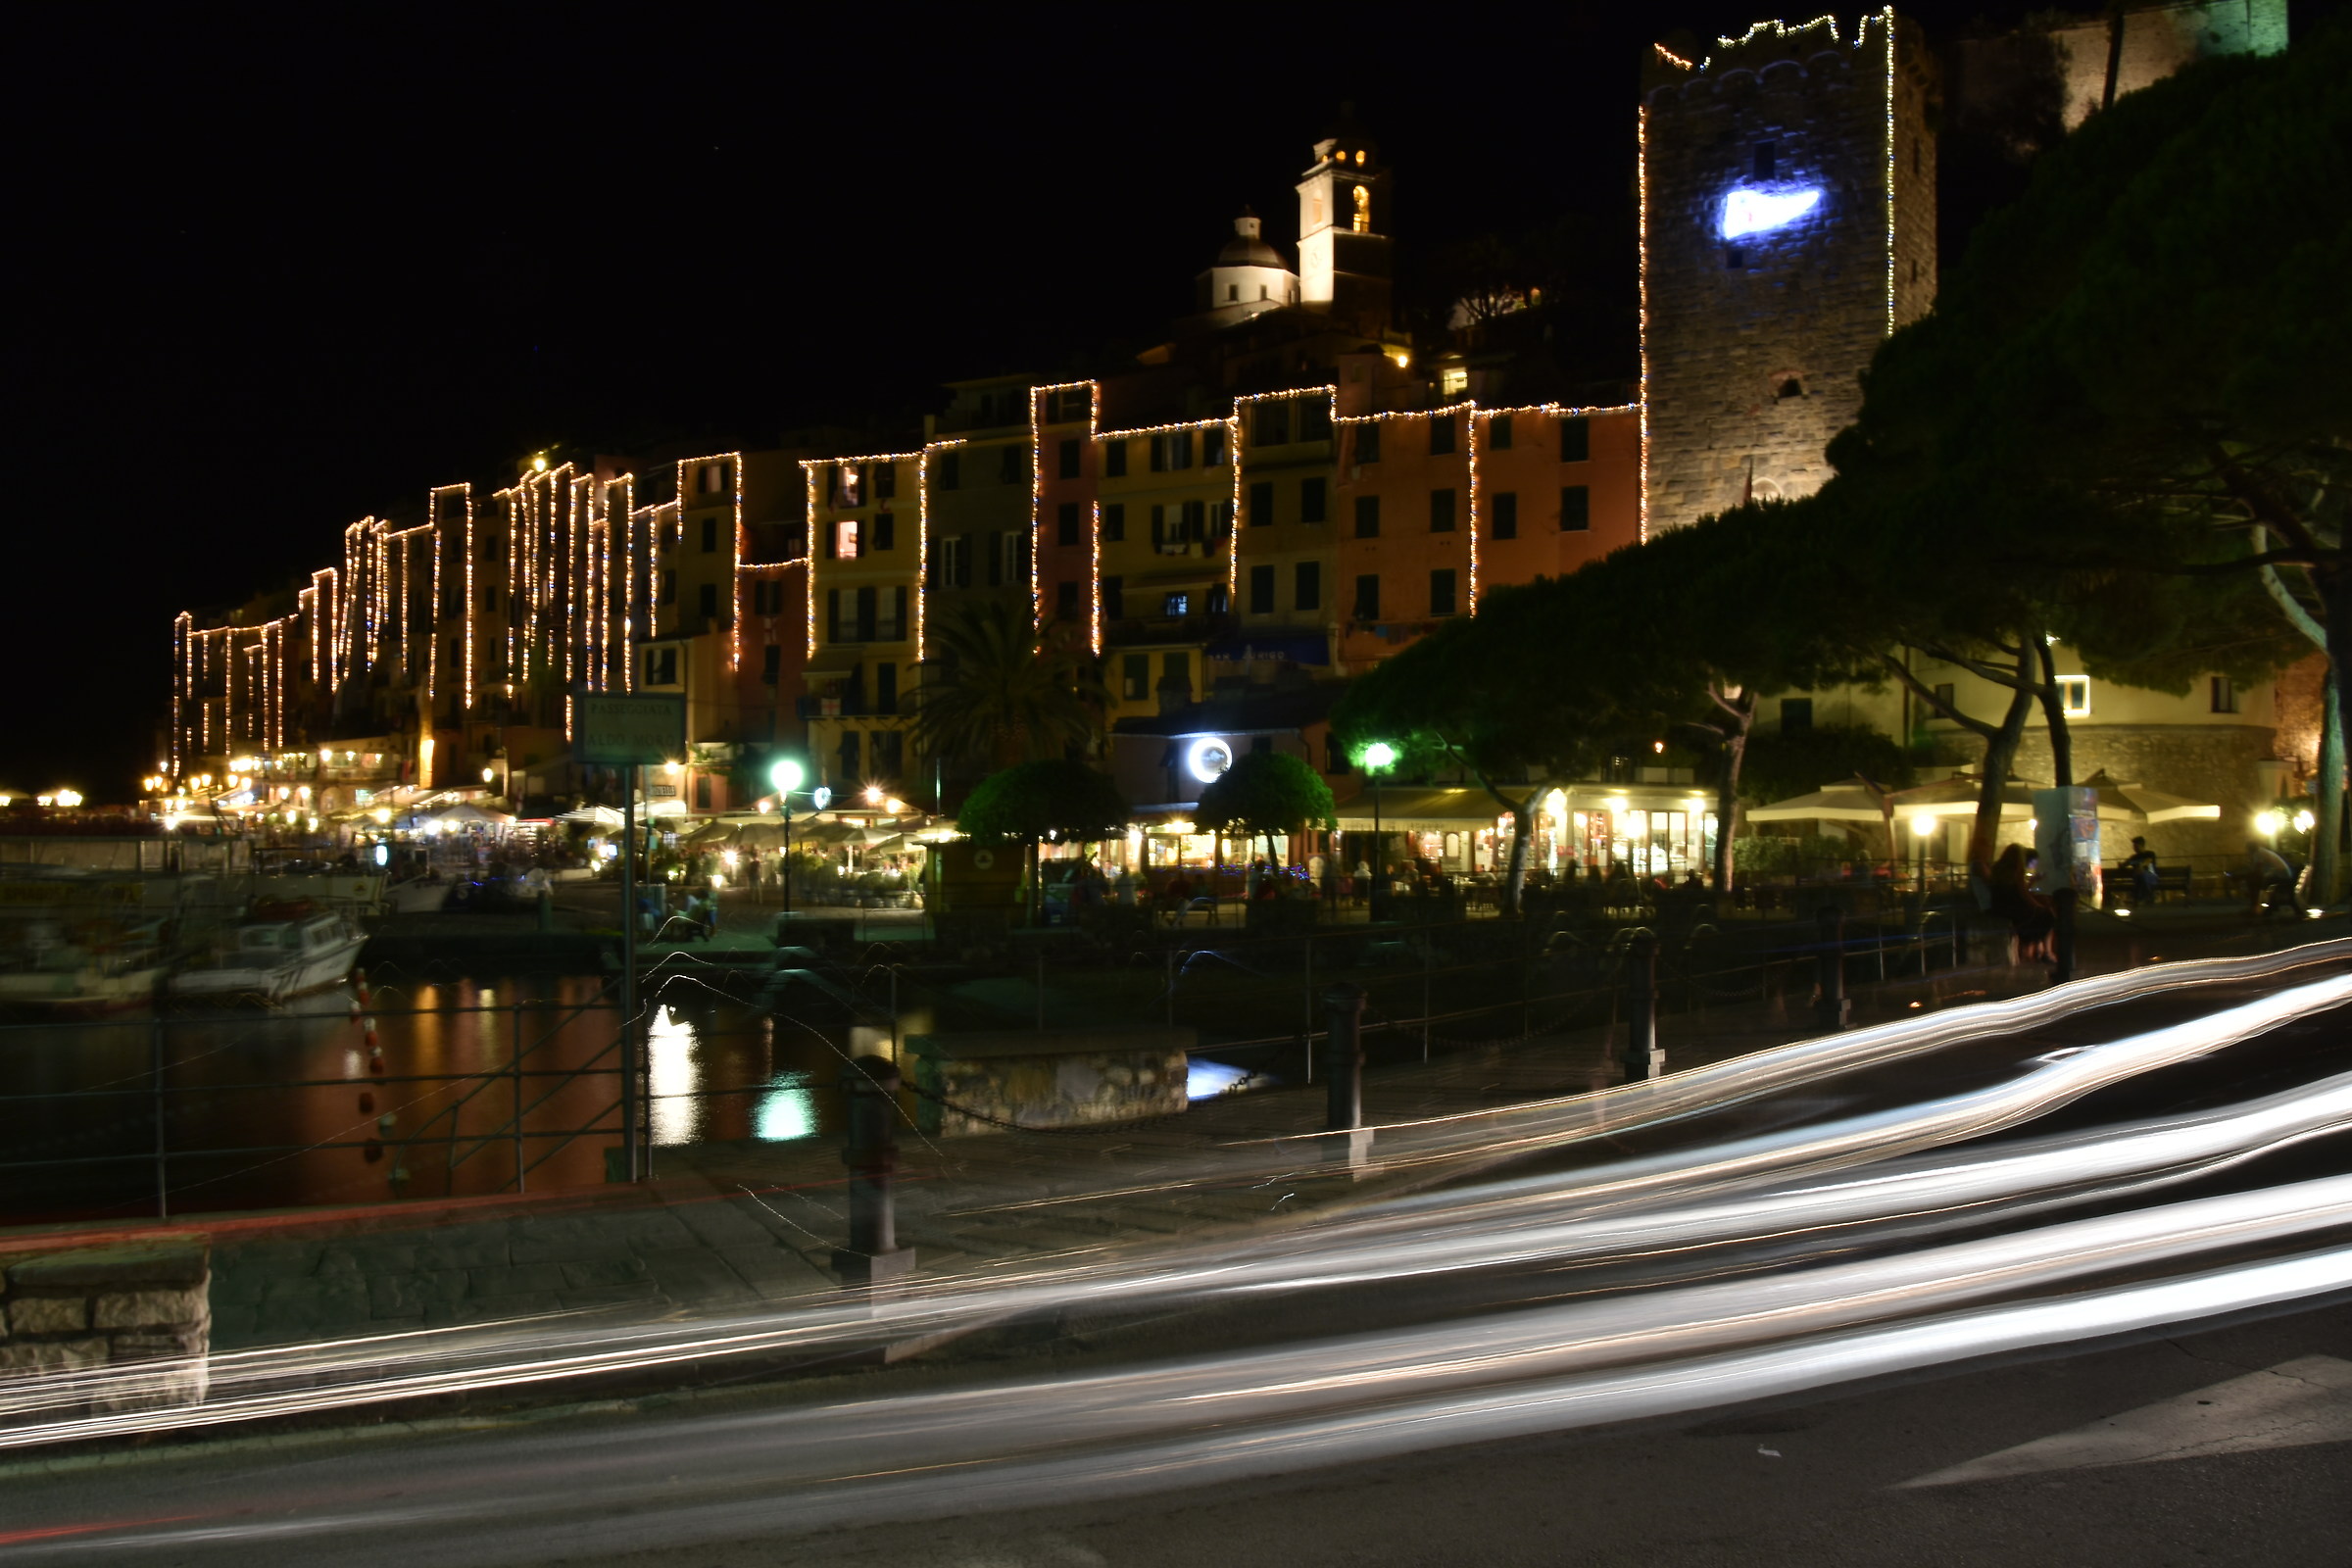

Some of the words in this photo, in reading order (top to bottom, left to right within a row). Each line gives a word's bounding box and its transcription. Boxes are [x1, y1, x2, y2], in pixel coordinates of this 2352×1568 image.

[591, 703, 672, 715] PASSEGGIATA
[586, 733, 625, 746] ALDO
[633, 733, 675, 747] MORO
